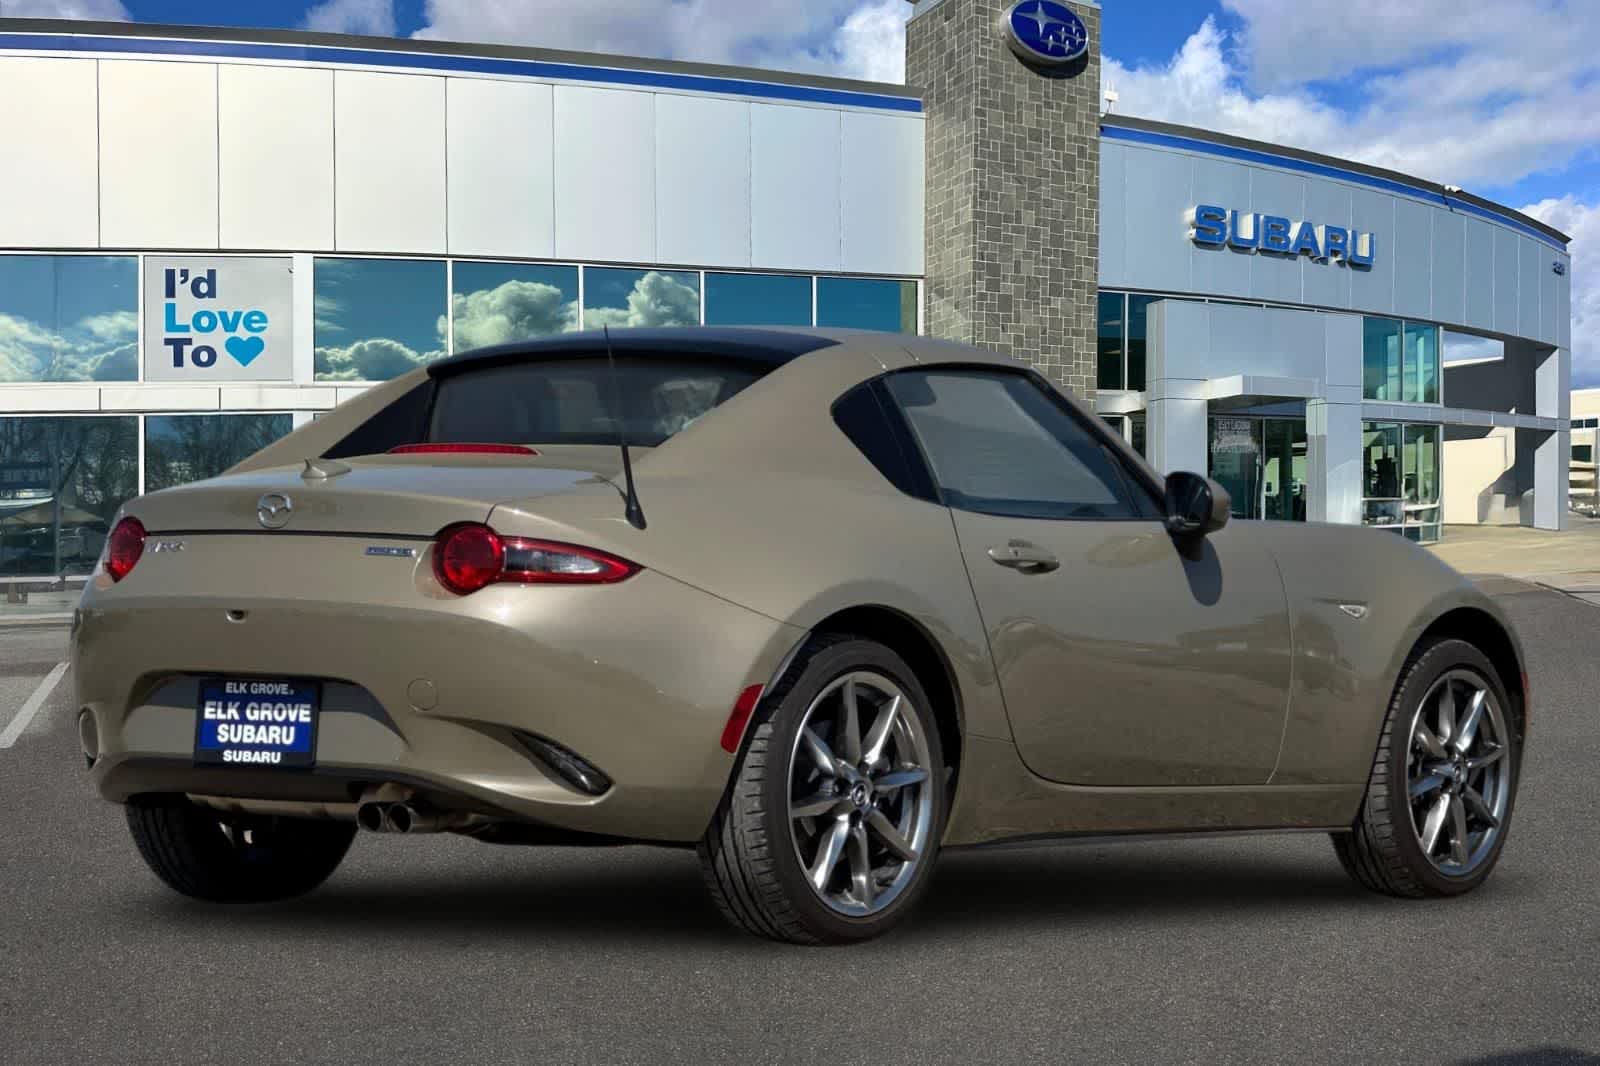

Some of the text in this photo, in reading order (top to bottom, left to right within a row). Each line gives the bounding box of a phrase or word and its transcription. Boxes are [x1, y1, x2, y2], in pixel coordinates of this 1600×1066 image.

[1190, 204, 1375, 271] SUBARU
[164, 268, 217, 299] I'd
[164, 302, 268, 333] Love
[164, 337, 217, 368] To
[225, 682, 248, 694] ELK
[204, 701, 311, 722] ELK GROVE
[217, 723, 295, 745] SUBARU
[223, 750, 281, 763] SUBARU
